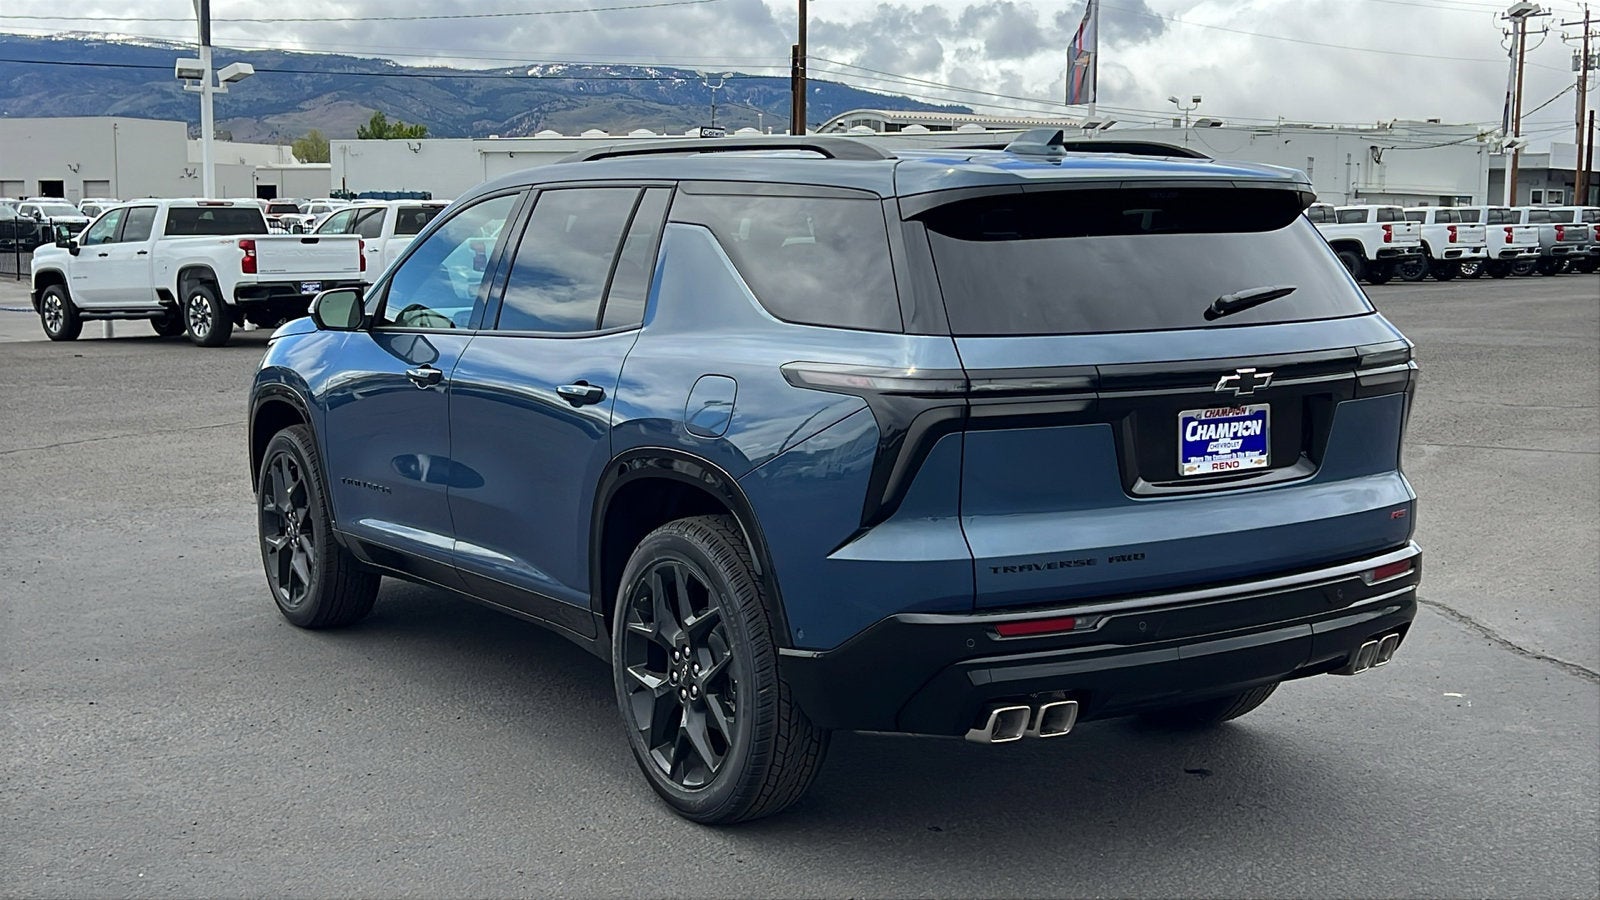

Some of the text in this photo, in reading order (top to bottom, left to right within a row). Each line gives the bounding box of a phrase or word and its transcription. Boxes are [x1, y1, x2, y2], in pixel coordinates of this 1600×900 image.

[1204, 406, 1247, 418] CHAMPION
[1185, 419, 1262, 441] CHAMPION
[1209, 441, 1240, 450] CHEVROLET
[1212, 460, 1239, 470] RENO
[988, 558, 1098, 574] TRAVERSE
